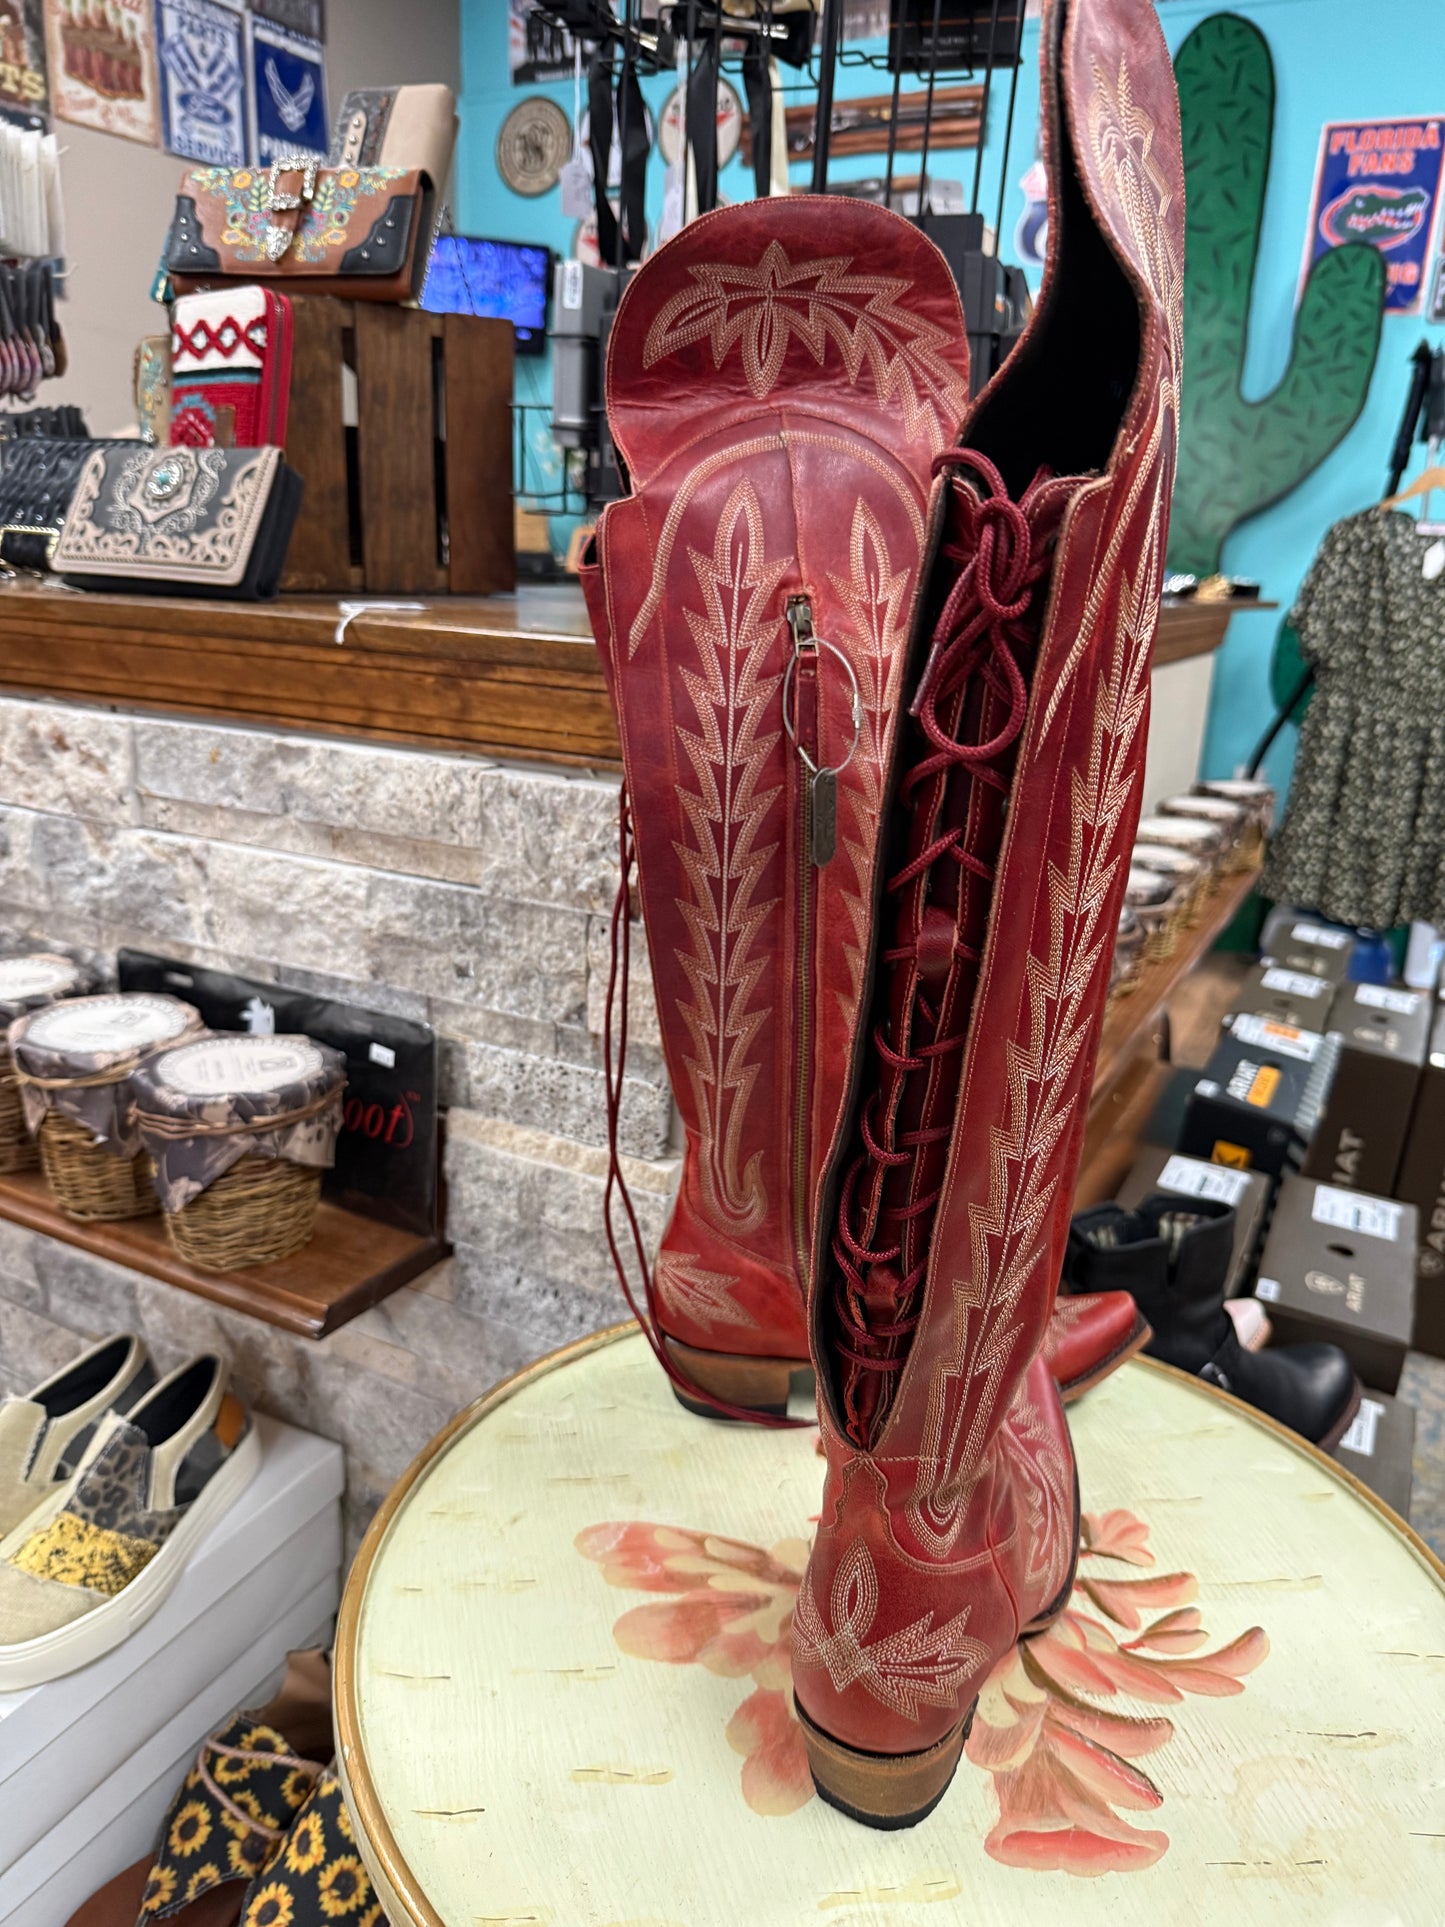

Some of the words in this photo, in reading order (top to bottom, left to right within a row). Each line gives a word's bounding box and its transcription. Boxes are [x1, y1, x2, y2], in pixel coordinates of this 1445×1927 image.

[174, 134, 241, 165] SERVICE
[1330, 126, 1440, 154] FLORIDA
[1348, 150, 1415, 176] FANS
[1226, 1058, 1261, 1101] ARIAT
[1332, 1128, 1363, 1185] IAT
[1345, 1272, 1366, 1314] ARIAT
